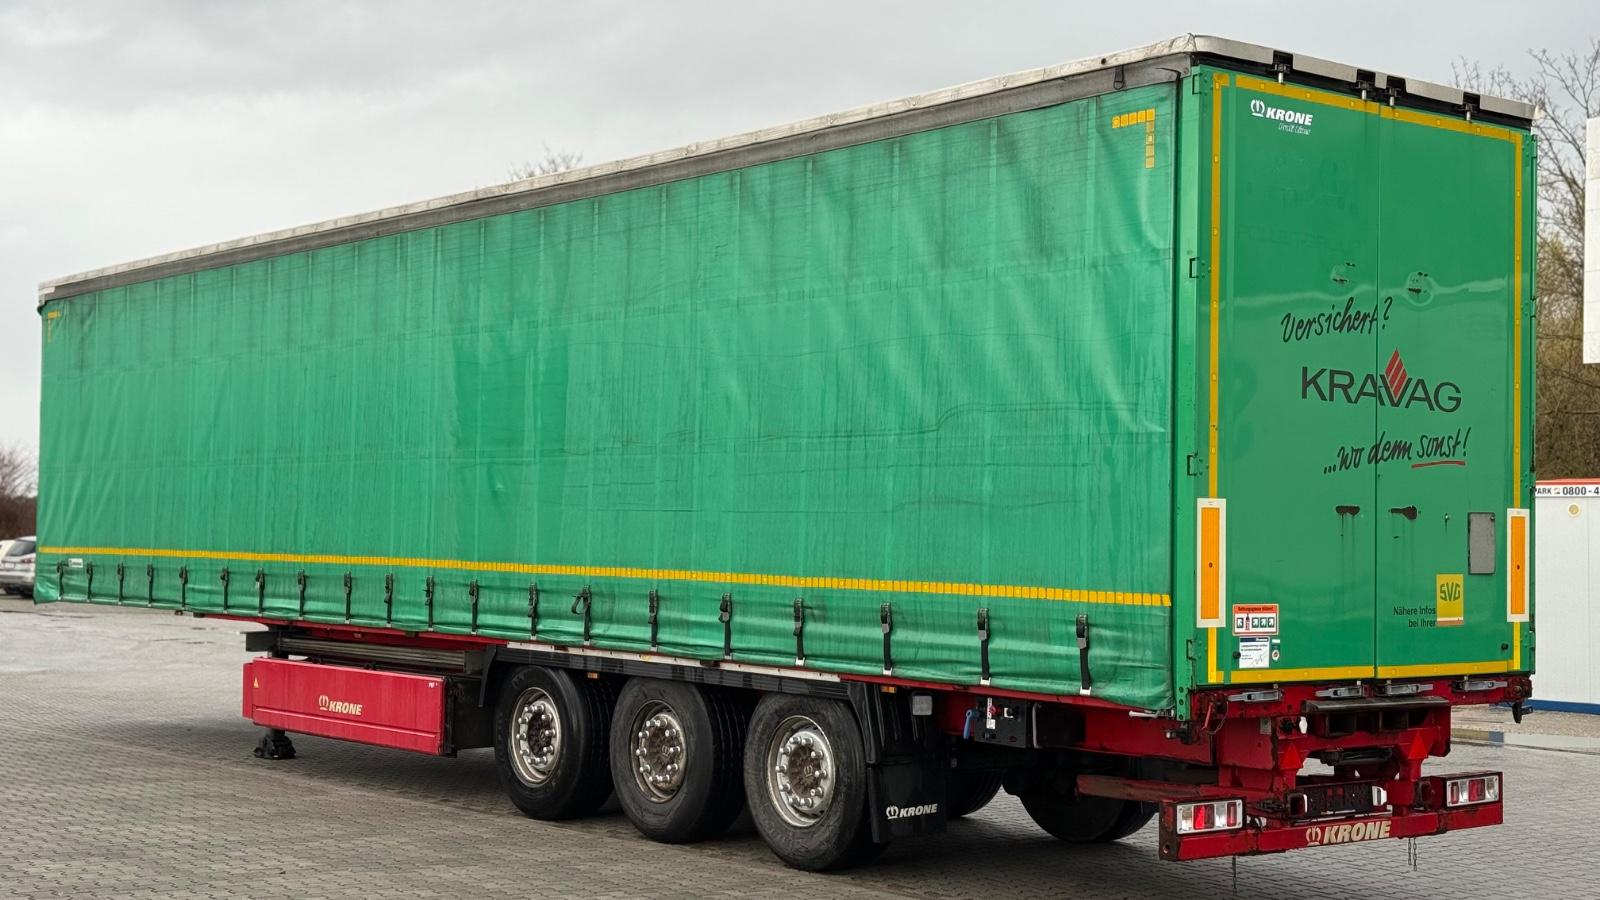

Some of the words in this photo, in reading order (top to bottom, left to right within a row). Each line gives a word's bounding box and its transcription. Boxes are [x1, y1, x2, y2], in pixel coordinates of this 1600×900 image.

[1265, 106, 1313, 126] KRONE
[1301, 365, 1462, 413] KRAVAG
[1367, 431, 1412, 464] denn
[1416, 427, 1471, 458] sonst!
[1440, 582, 1461, 602] SVG
[1393, 606, 1418, 616] Nähere
[1419, 605, 1436, 615] Infos
[1408, 619, 1419, 628] bei
[1420, 619, 1436, 627] Ihrer
[329, 701, 363, 716] KRONE
[899, 803, 938, 818] KRONE
[1323, 820, 1392, 844] KRONE
